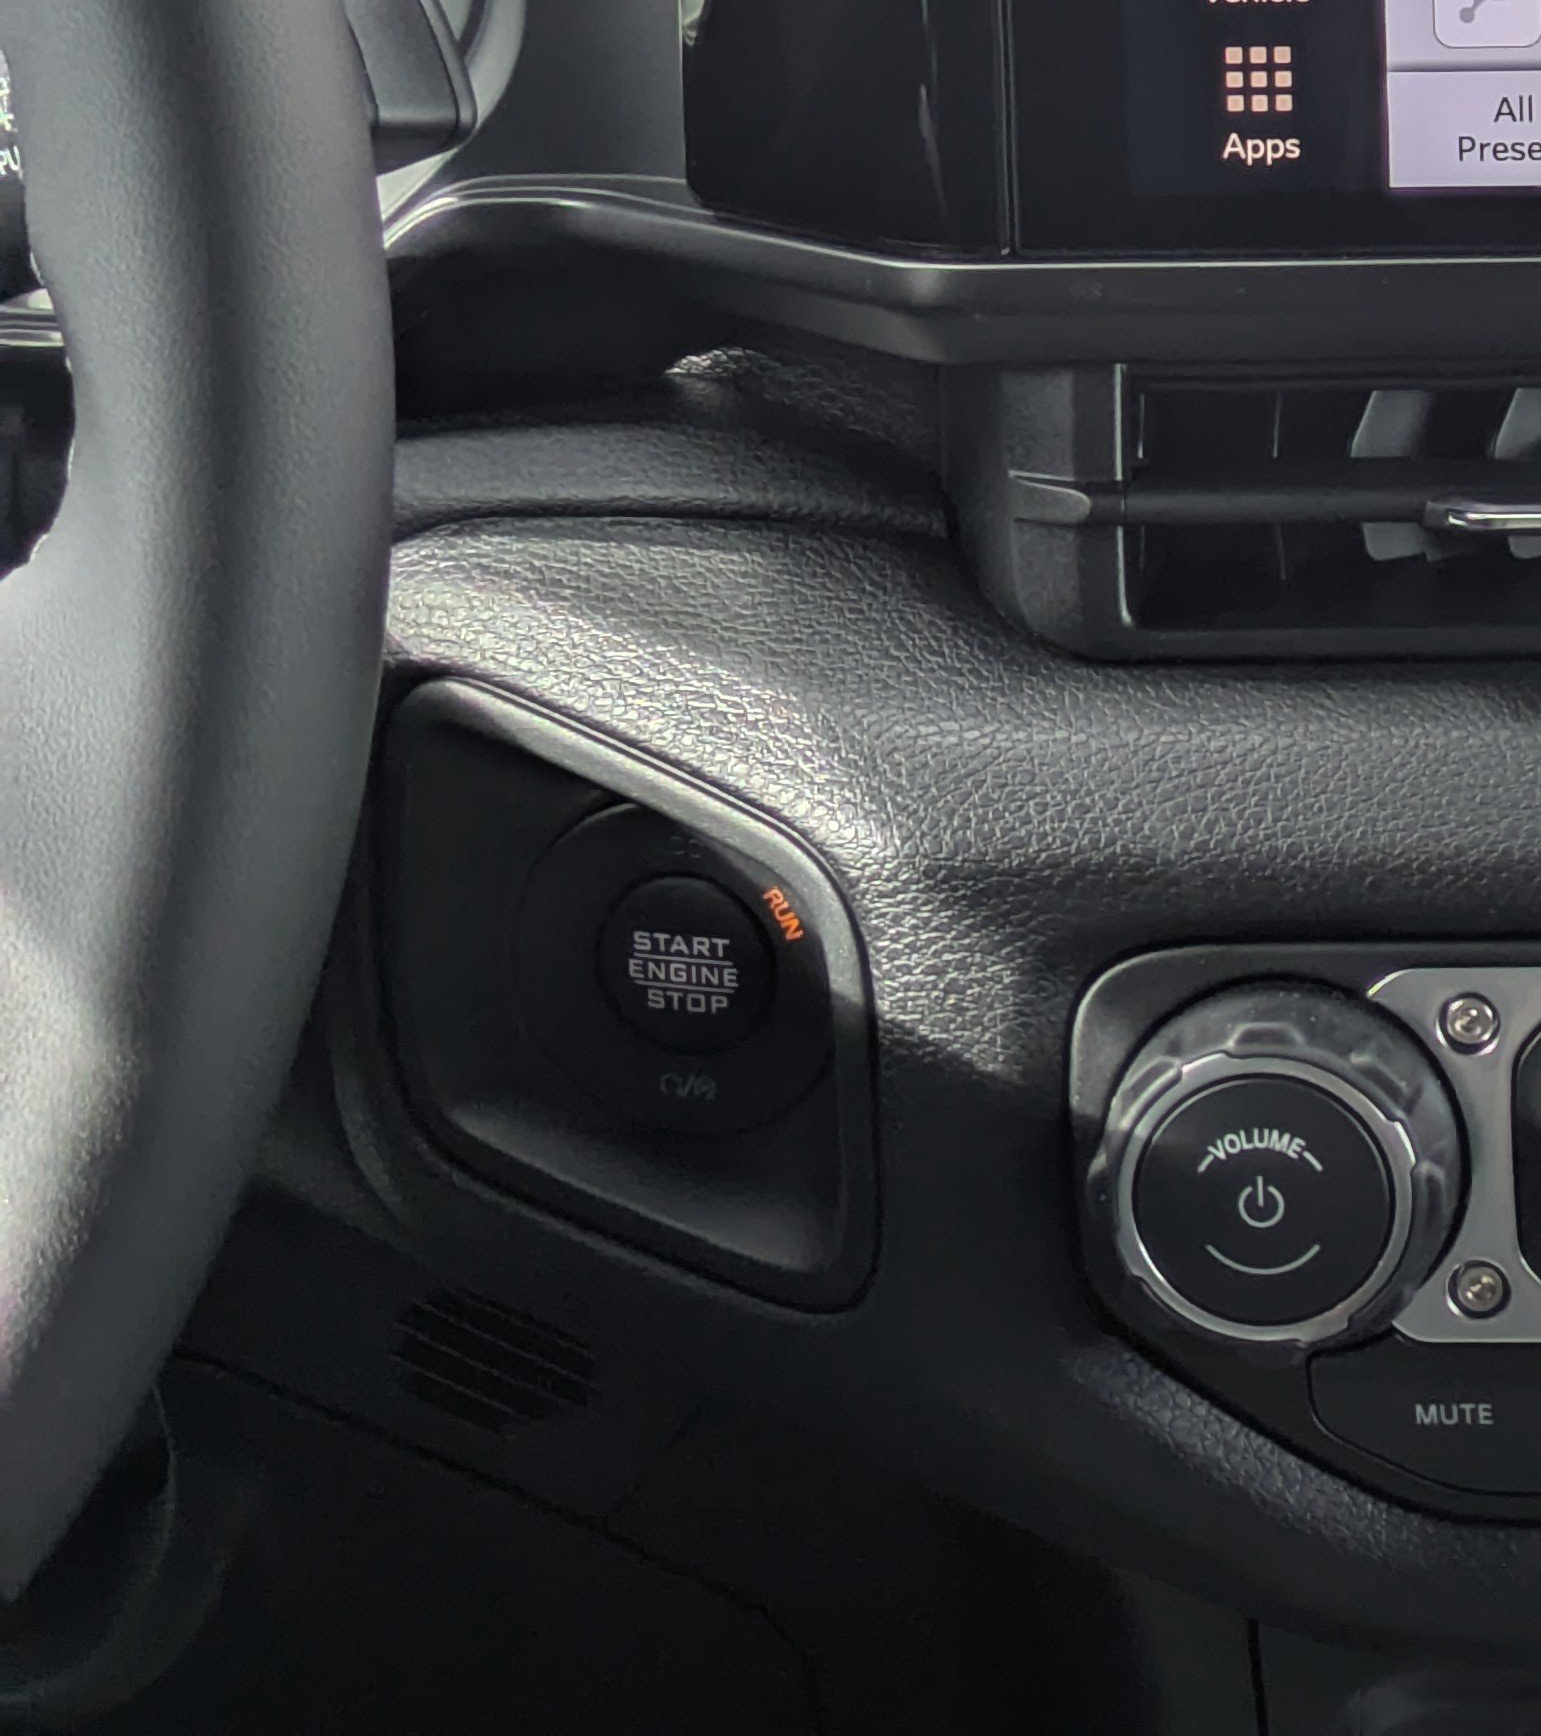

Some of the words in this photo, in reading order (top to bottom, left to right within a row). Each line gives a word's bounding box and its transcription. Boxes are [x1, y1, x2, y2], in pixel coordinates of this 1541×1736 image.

[1494, 94, 1533, 123] All
[1222, 133, 1301, 165] Apps
[762, 884, 804, 942] RUN
[632, 930, 730, 958] START
[628, 959, 739, 988] ENGINE
[647, 988, 729, 1014] STOP
[1209, 1127, 1305, 1160] VOLUME
[1415, 1403, 1494, 1425] MUTE
